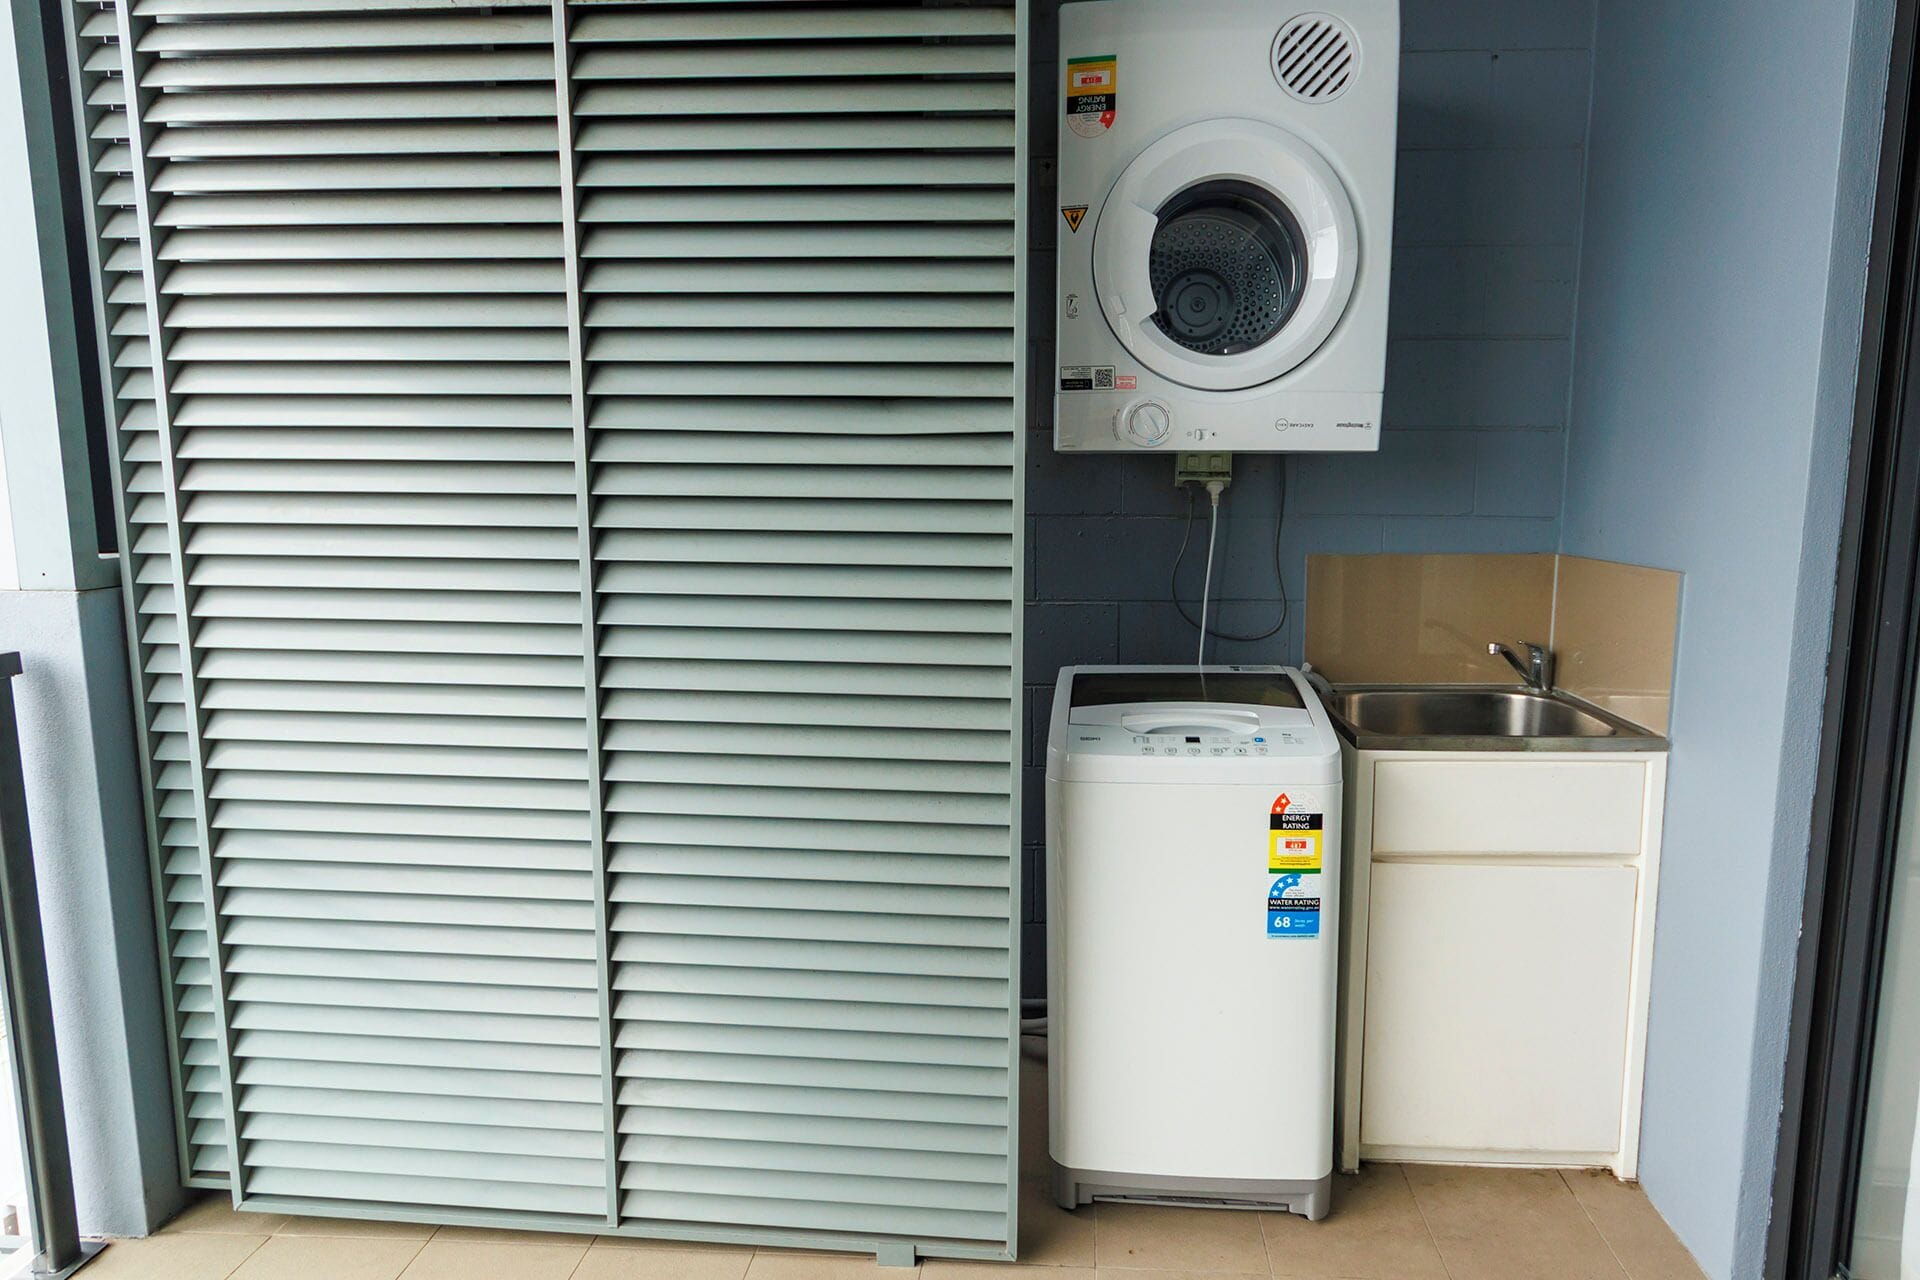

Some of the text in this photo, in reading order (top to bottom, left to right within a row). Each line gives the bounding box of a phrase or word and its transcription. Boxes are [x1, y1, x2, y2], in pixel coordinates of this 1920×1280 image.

[1078, 96, 1106, 104] RATING
[1076, 103, 1107, 112] ENERGY
[1274, 916, 1291, 928] 68
